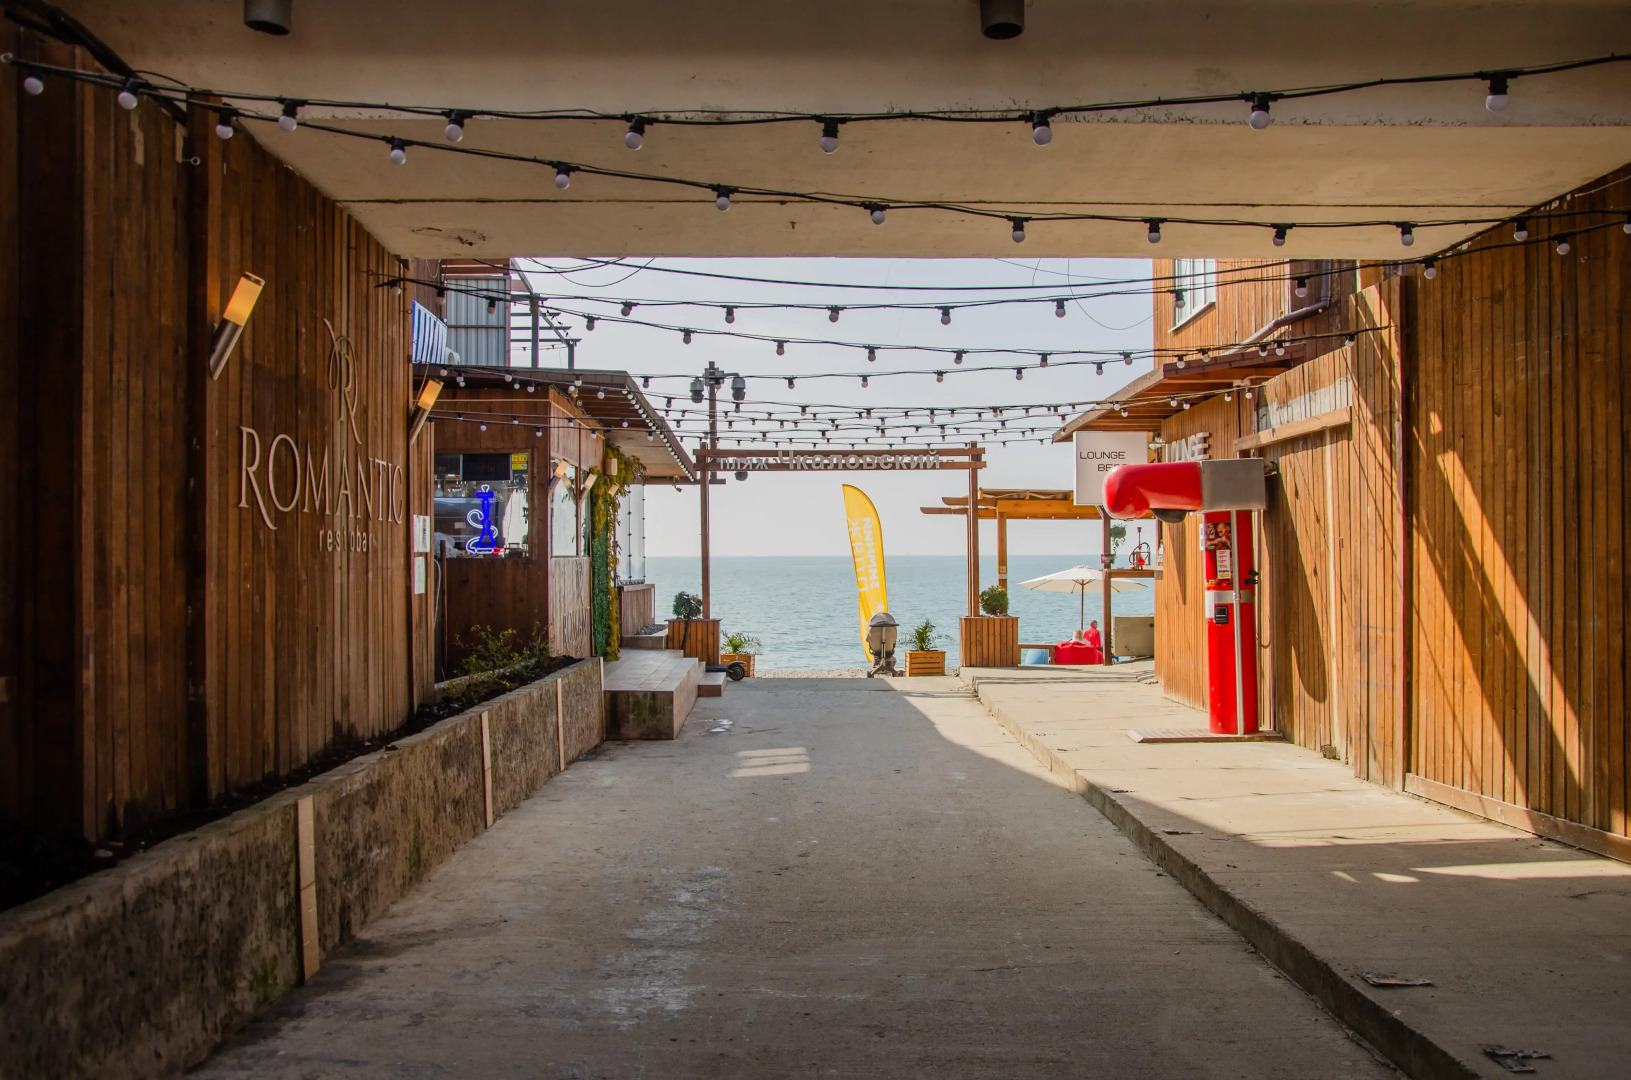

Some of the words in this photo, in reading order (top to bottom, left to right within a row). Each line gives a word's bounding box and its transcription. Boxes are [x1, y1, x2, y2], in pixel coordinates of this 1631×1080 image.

[720, 457, 769, 470] пляж
[778, 448, 940, 470] Чкаловский
[1079, 451, 1126, 460] LOUNGE
[1165, 432, 1209, 463] LOUNGE
[238, 426, 403, 530] ROMANTIC
[318, 525, 373, 552] restobar
